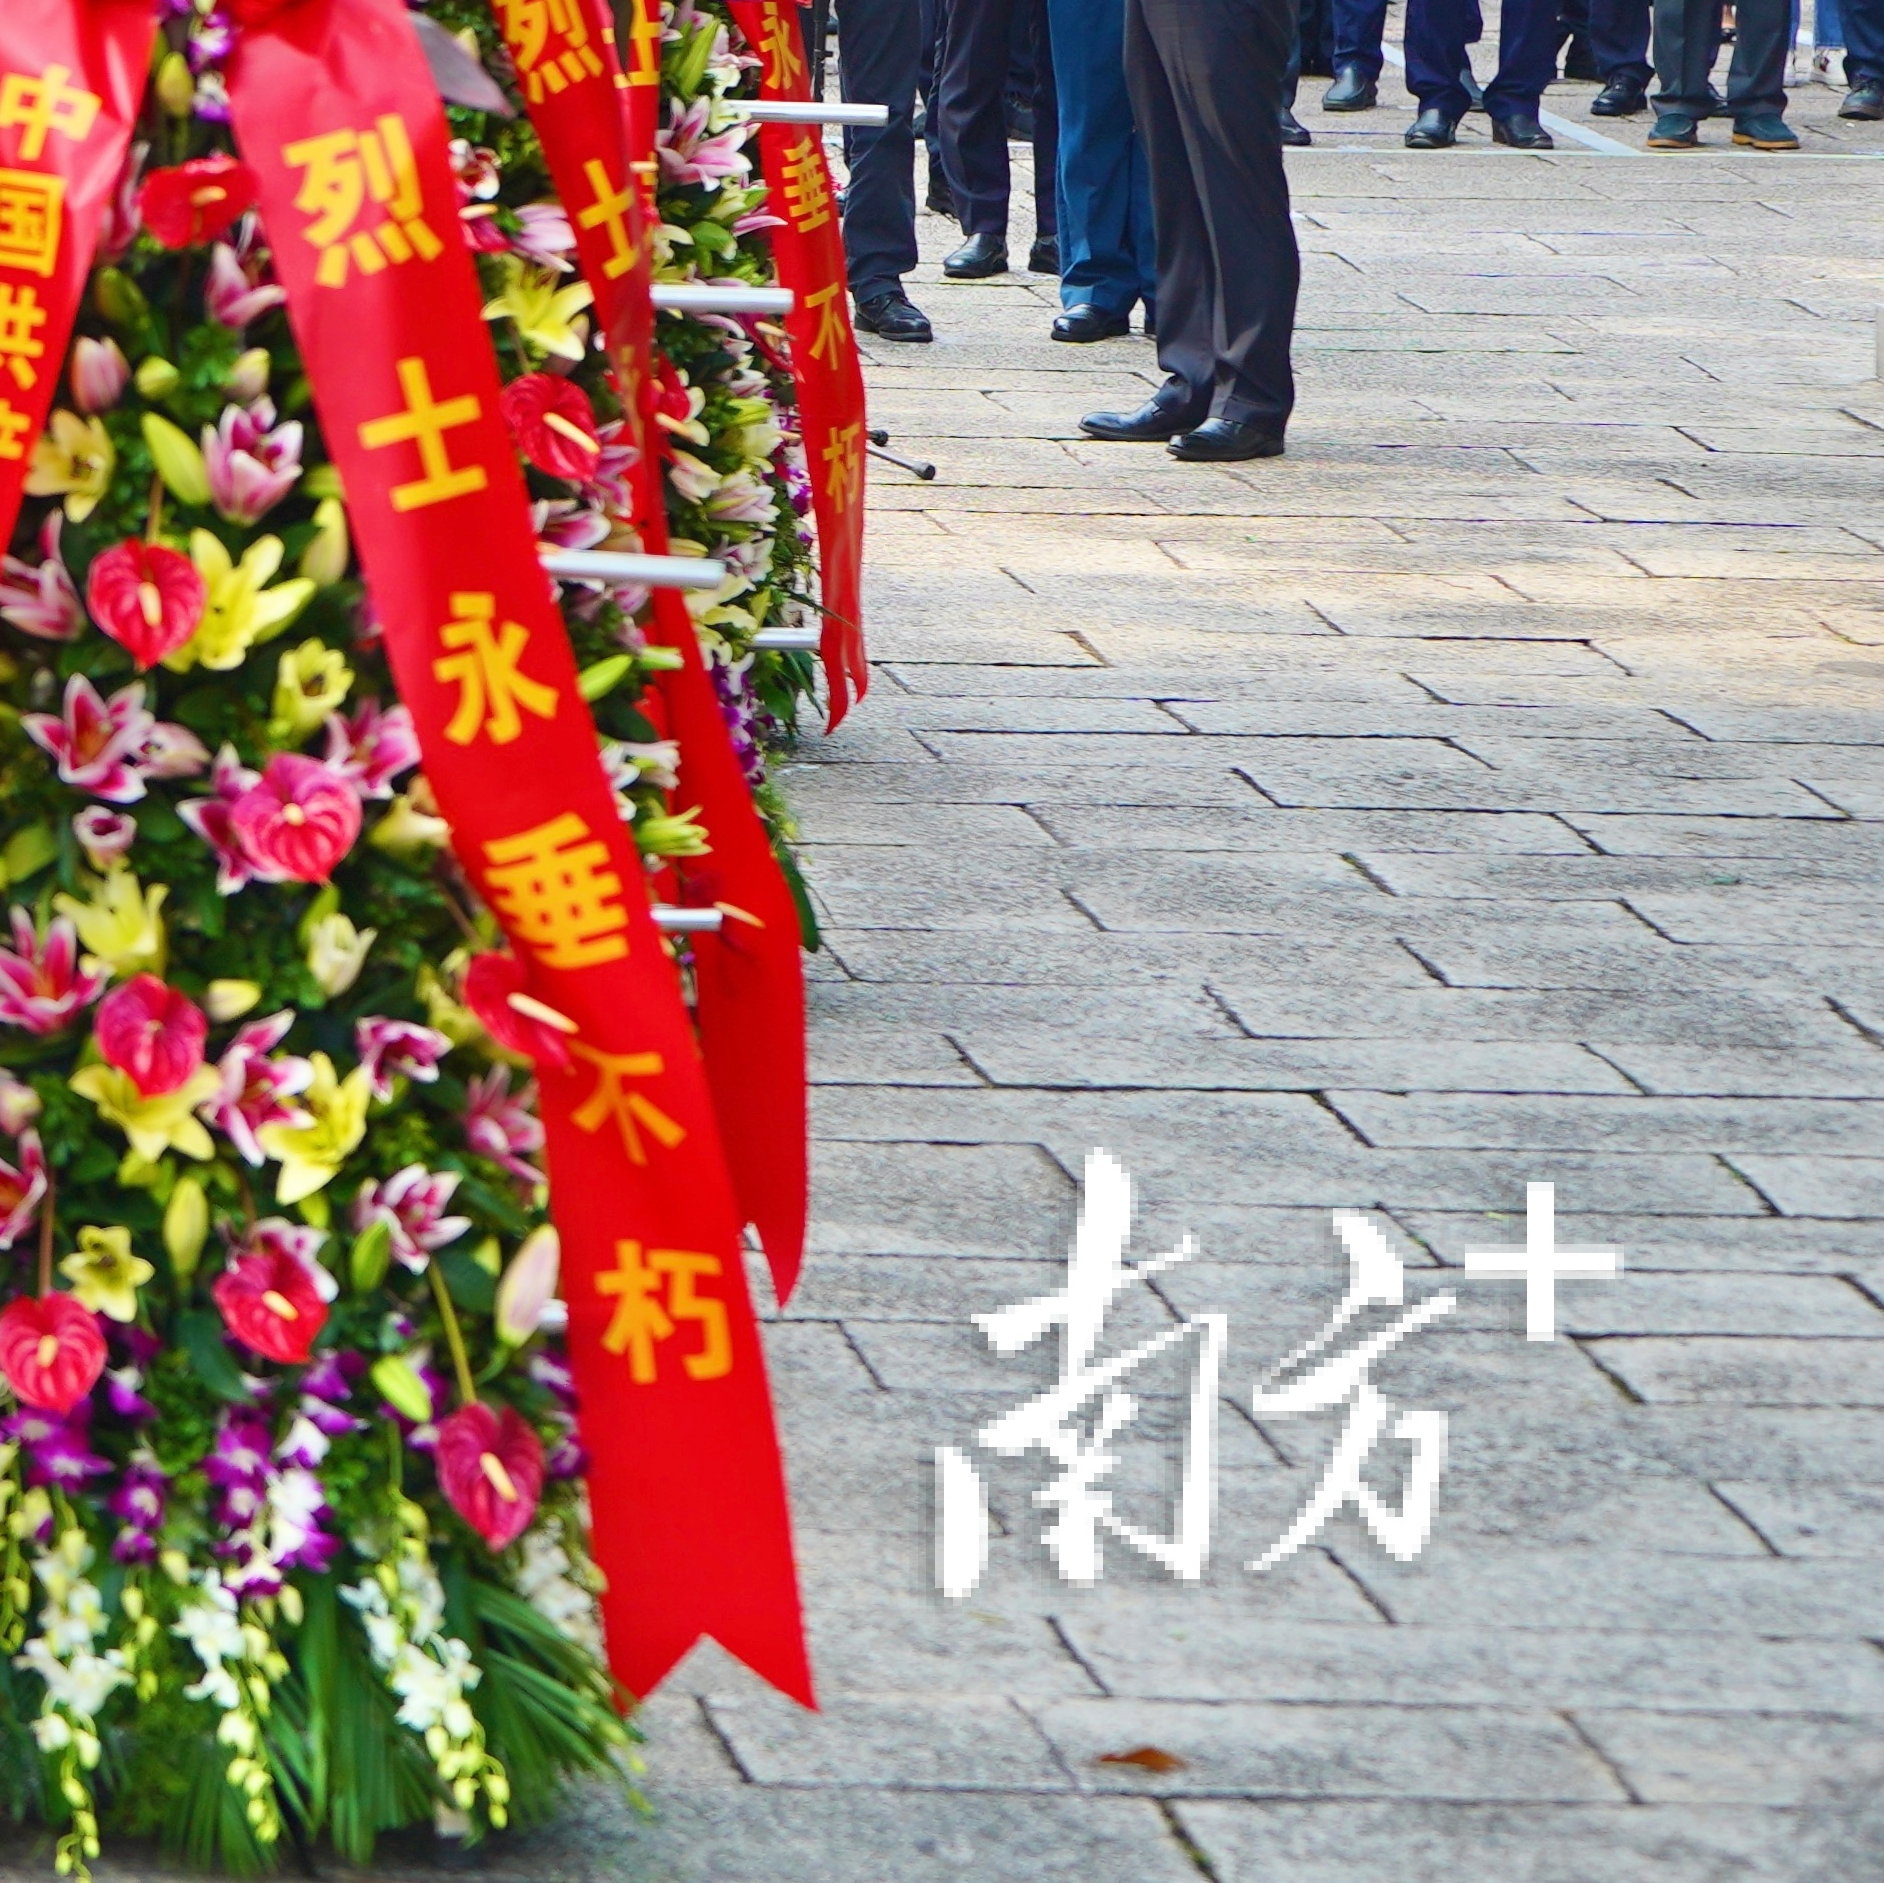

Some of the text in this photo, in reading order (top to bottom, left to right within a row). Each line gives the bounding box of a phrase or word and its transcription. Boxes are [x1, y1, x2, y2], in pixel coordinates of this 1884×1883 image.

[283, 113, 733, 1384] 烈士永垂不朽
